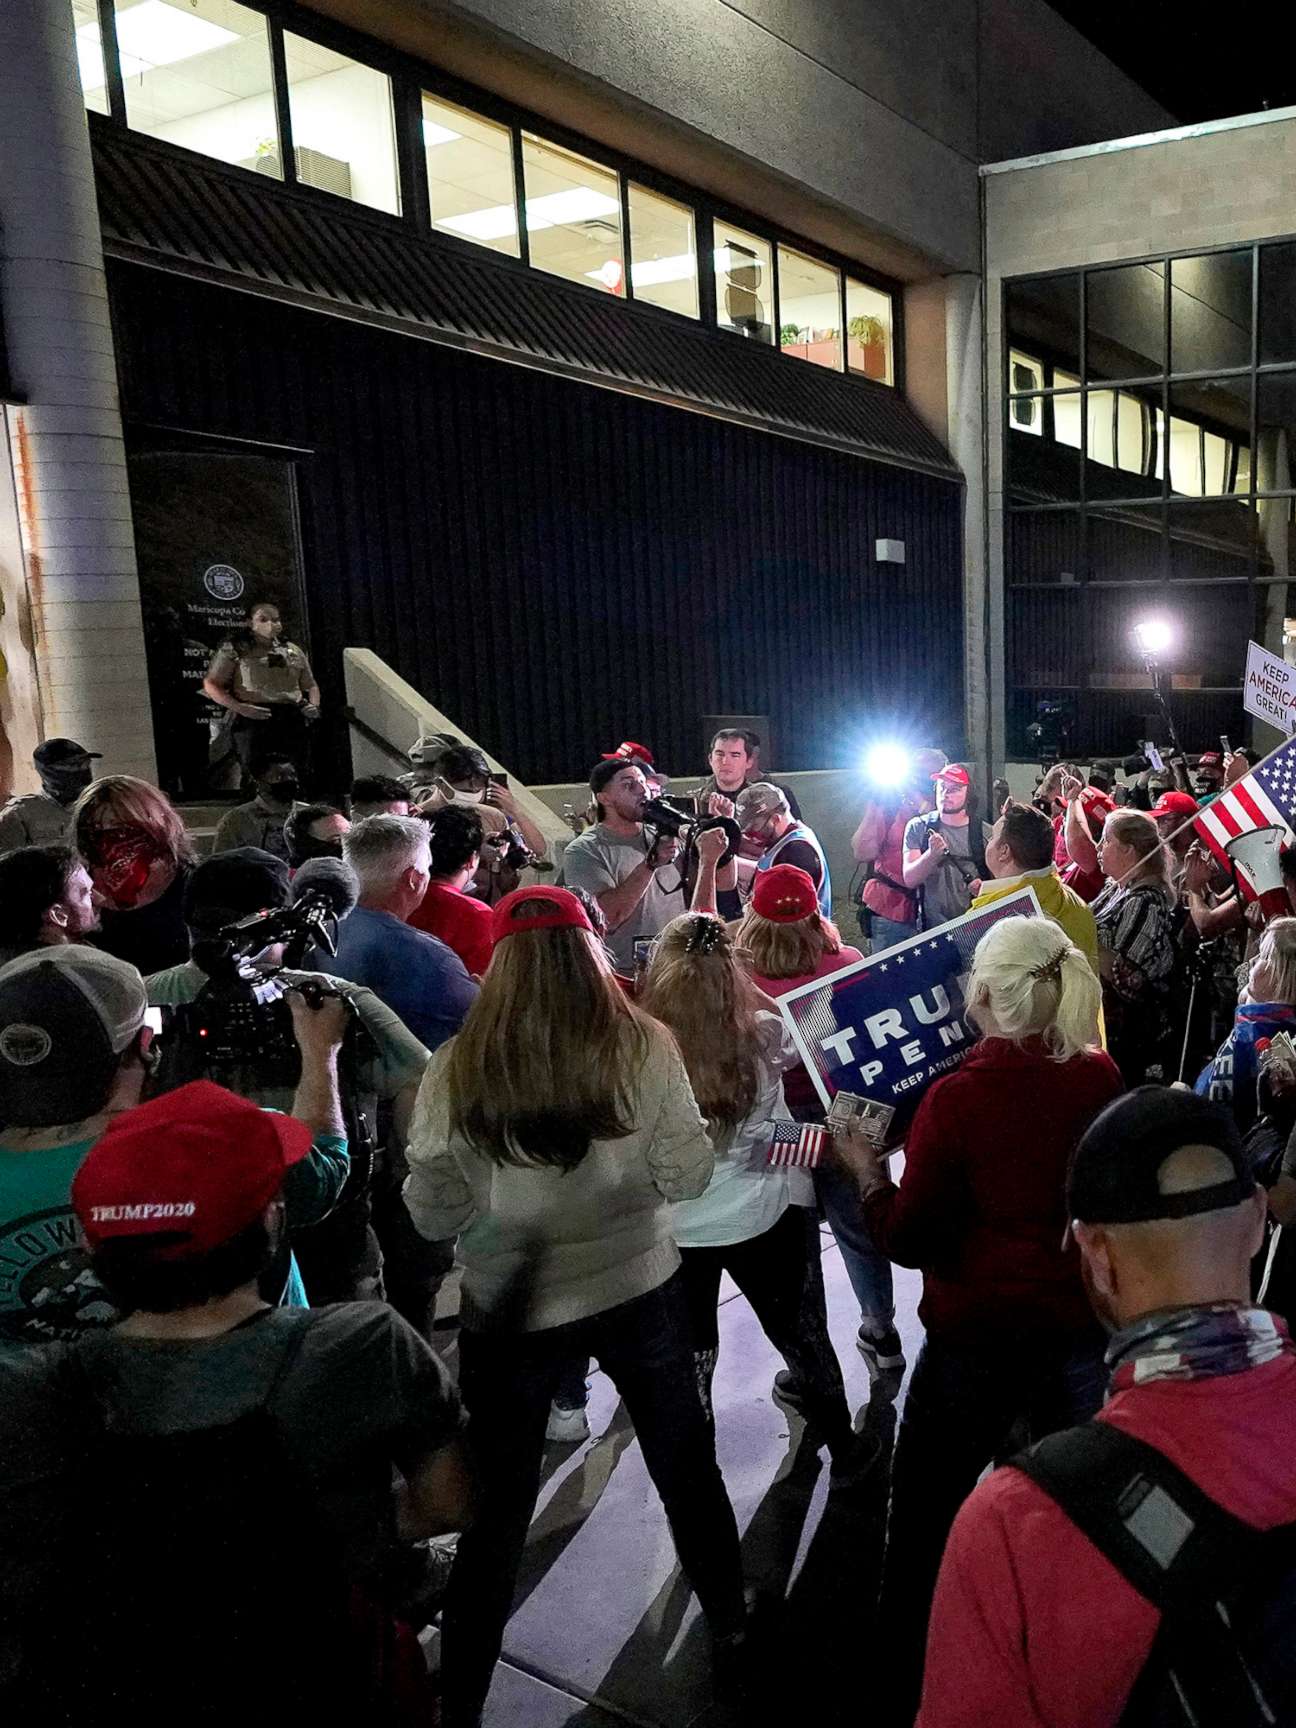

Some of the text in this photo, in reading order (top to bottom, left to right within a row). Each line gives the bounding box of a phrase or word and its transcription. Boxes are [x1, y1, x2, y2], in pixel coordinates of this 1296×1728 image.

[232, 608, 246, 616] Co
[184, 648, 206, 657] NOT
[1262, 660, 1290, 685] KEEP
[1255, 693, 1288, 722] GREAT!
[892, 1071, 925, 1094] KEEP
[91, 1201, 197, 1222] TRUMP2020
